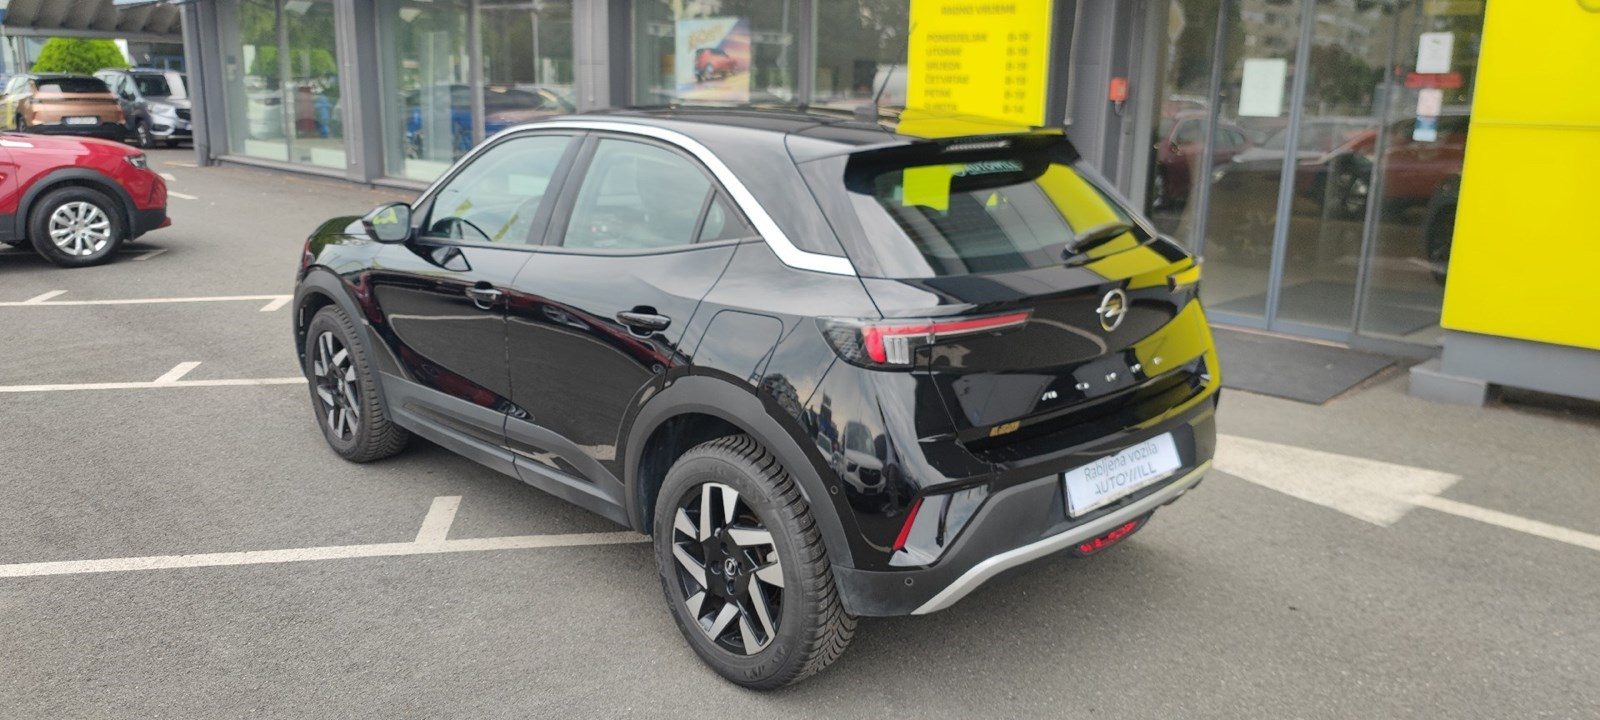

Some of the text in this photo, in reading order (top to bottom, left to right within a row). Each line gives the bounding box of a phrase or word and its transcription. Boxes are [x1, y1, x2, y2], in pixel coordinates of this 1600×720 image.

[976, 4, 1015, 14] VRIJEME
[925, 48, 962, 57] UTORAK
[924, 89, 951, 98] PETAK
[1083, 440, 1158, 482] Rabljena vozila
[1094, 463, 1158, 495] AUTOWILL
